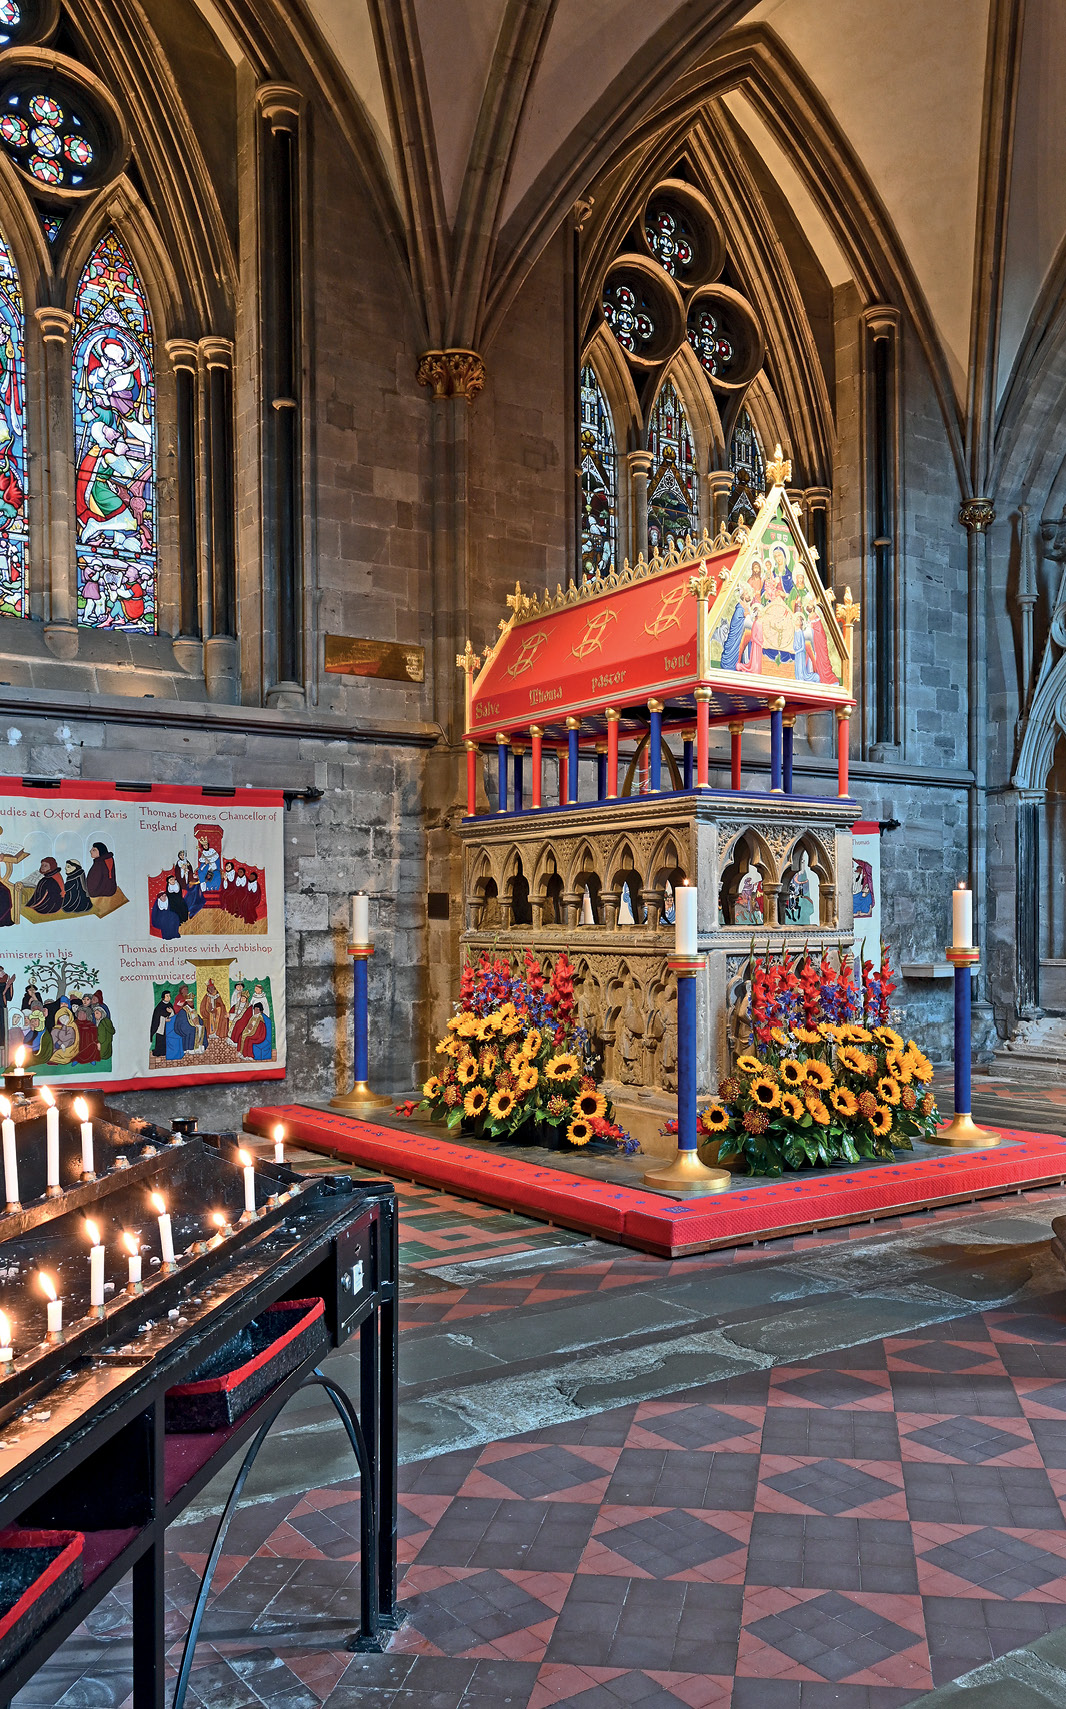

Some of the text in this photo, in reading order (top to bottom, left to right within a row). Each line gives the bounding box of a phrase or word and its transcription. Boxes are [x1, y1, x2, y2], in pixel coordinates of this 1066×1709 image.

[475, 701, 500, 720] Salve
[591, 669, 627, 692] pastor
[664, 652, 691, 672] bone
[30, 810, 41, 818] at
[43, 808, 80, 820] Oxford
[83, 809, 101, 819] and
[104, 808, 128, 819] Paris
[139, 806, 277, 822] Thomas becomes Chancellor of
[139, 820, 178, 832] England
[46, 949, 55, 959] in
[58, 948, 73, 959] his
[118, 943, 273, 954] Thomas disputes with Archbishop
[120, 957, 185, 968] Pecham and is
[120, 971, 196, 982] excommunicated
